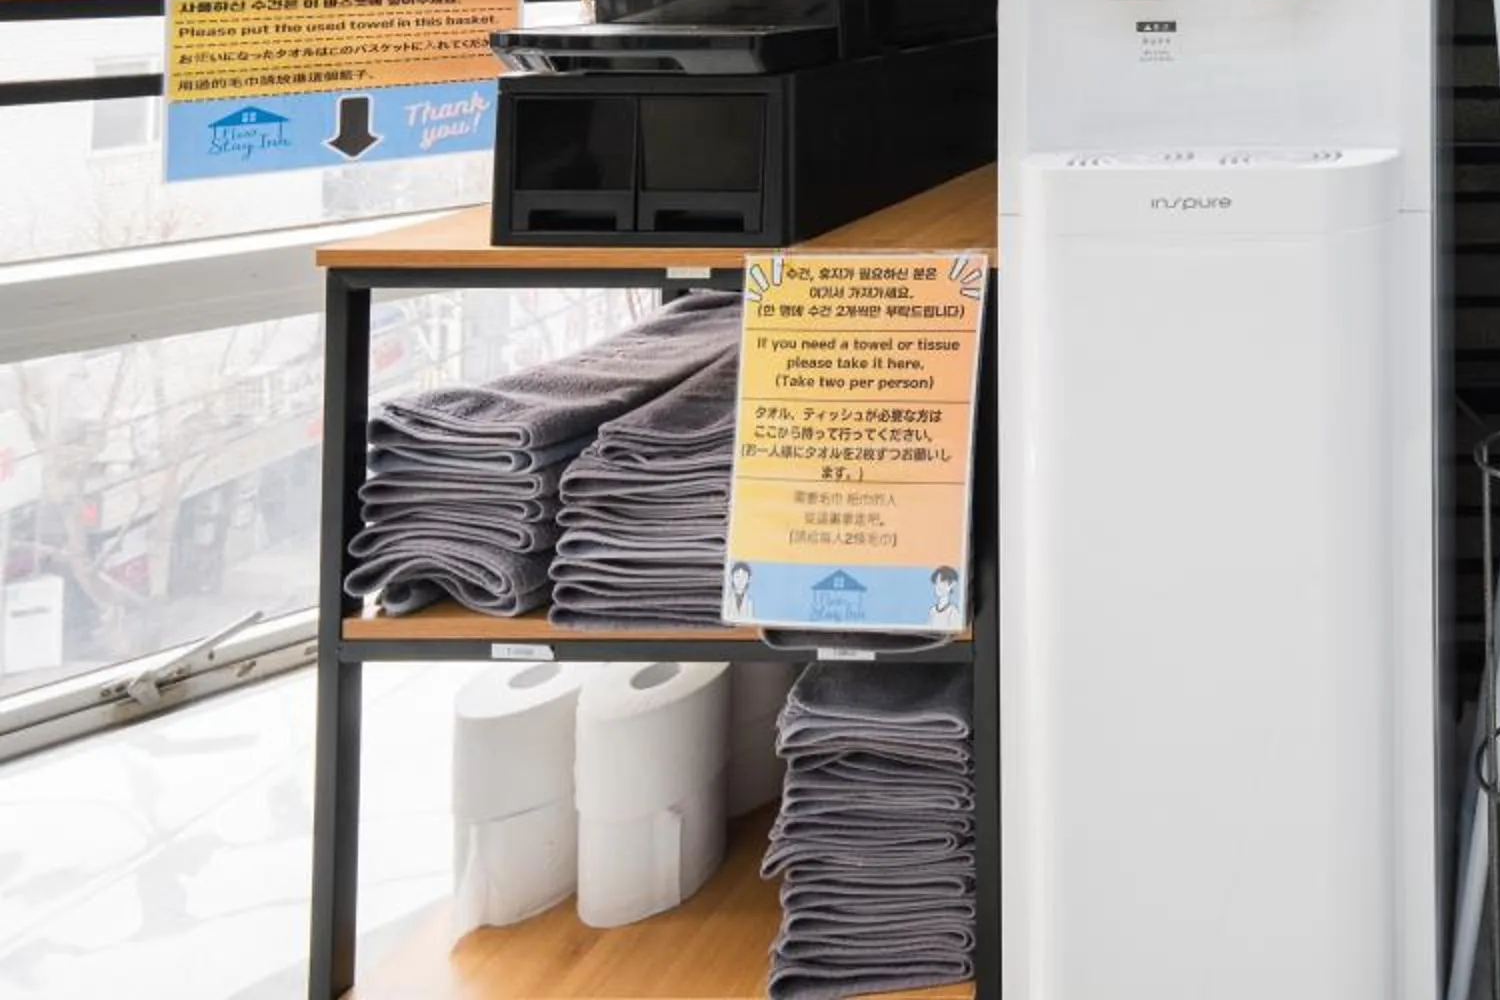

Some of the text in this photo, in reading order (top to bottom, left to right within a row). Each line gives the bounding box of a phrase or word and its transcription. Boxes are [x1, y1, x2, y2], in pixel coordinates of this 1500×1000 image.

[178, 27, 238, 39] Please
[241, 25, 269, 37] put
[275, 22, 303, 34] the
[306, 21, 346, 32] used
[350, 18, 395, 30] towel
[397, 17, 411, 28] in
[415, 15, 443, 27] this
[404, 90, 491, 126] Thank
[772, 340, 798, 352] you
[801, 338, 836, 350] need
[841, 341, 849, 350] a
[854, 338, 893, 350] towel
[897, 341, 914, 350] or
[917, 338, 961, 351] tissue
[786, 357, 833, 370] please
[837, 357, 868, 370] take
[872, 357, 884, 369] it
[775, 374, 935, 390] (Take two per person)
